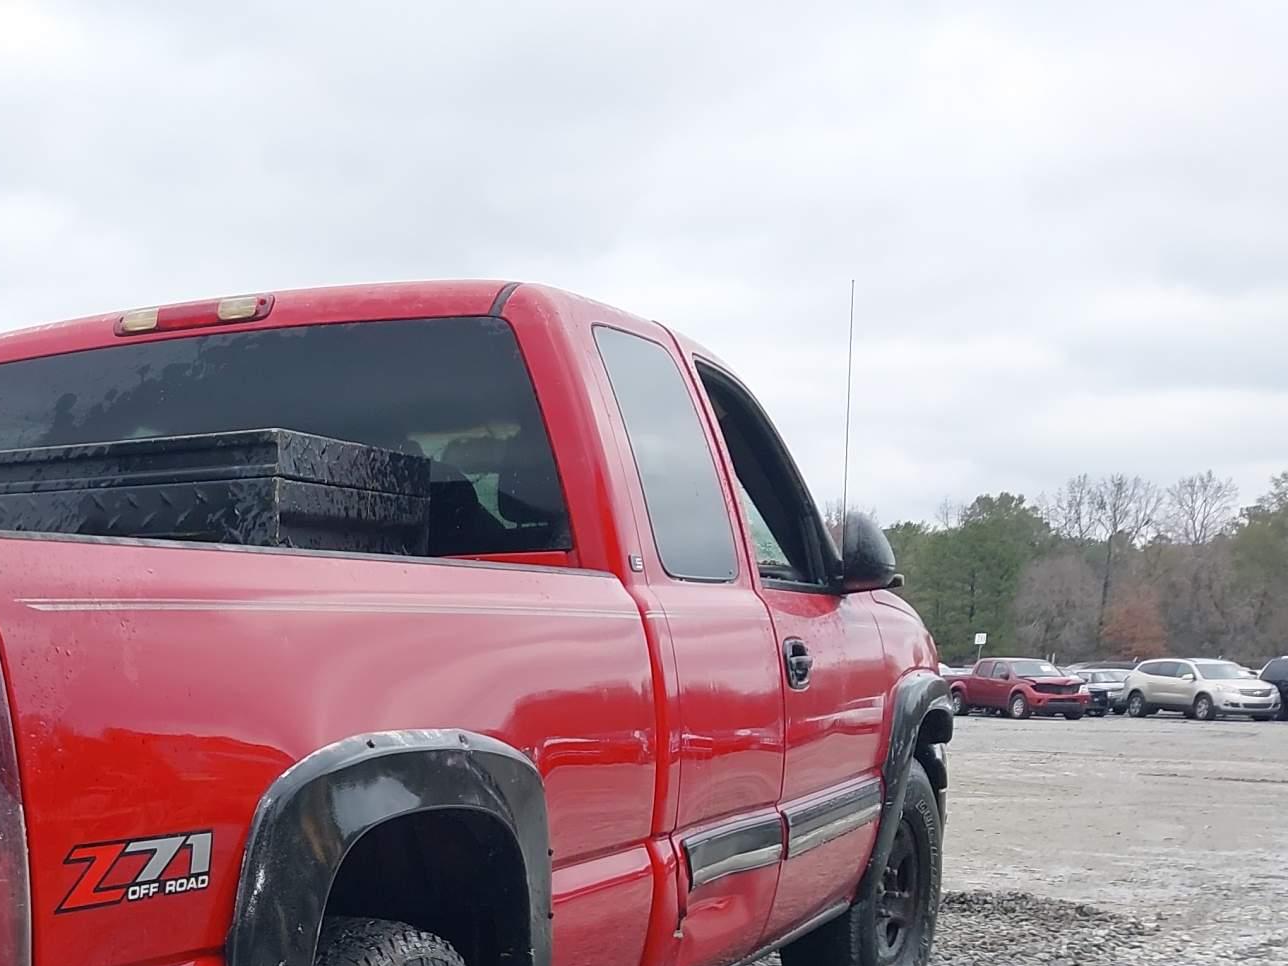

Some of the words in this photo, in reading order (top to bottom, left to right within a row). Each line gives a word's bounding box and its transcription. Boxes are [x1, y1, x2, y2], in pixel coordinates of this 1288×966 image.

[55, 829, 212, 914] Z71
[127, 882, 160, 900] OFF
[164, 875, 210, 895] ROAD
